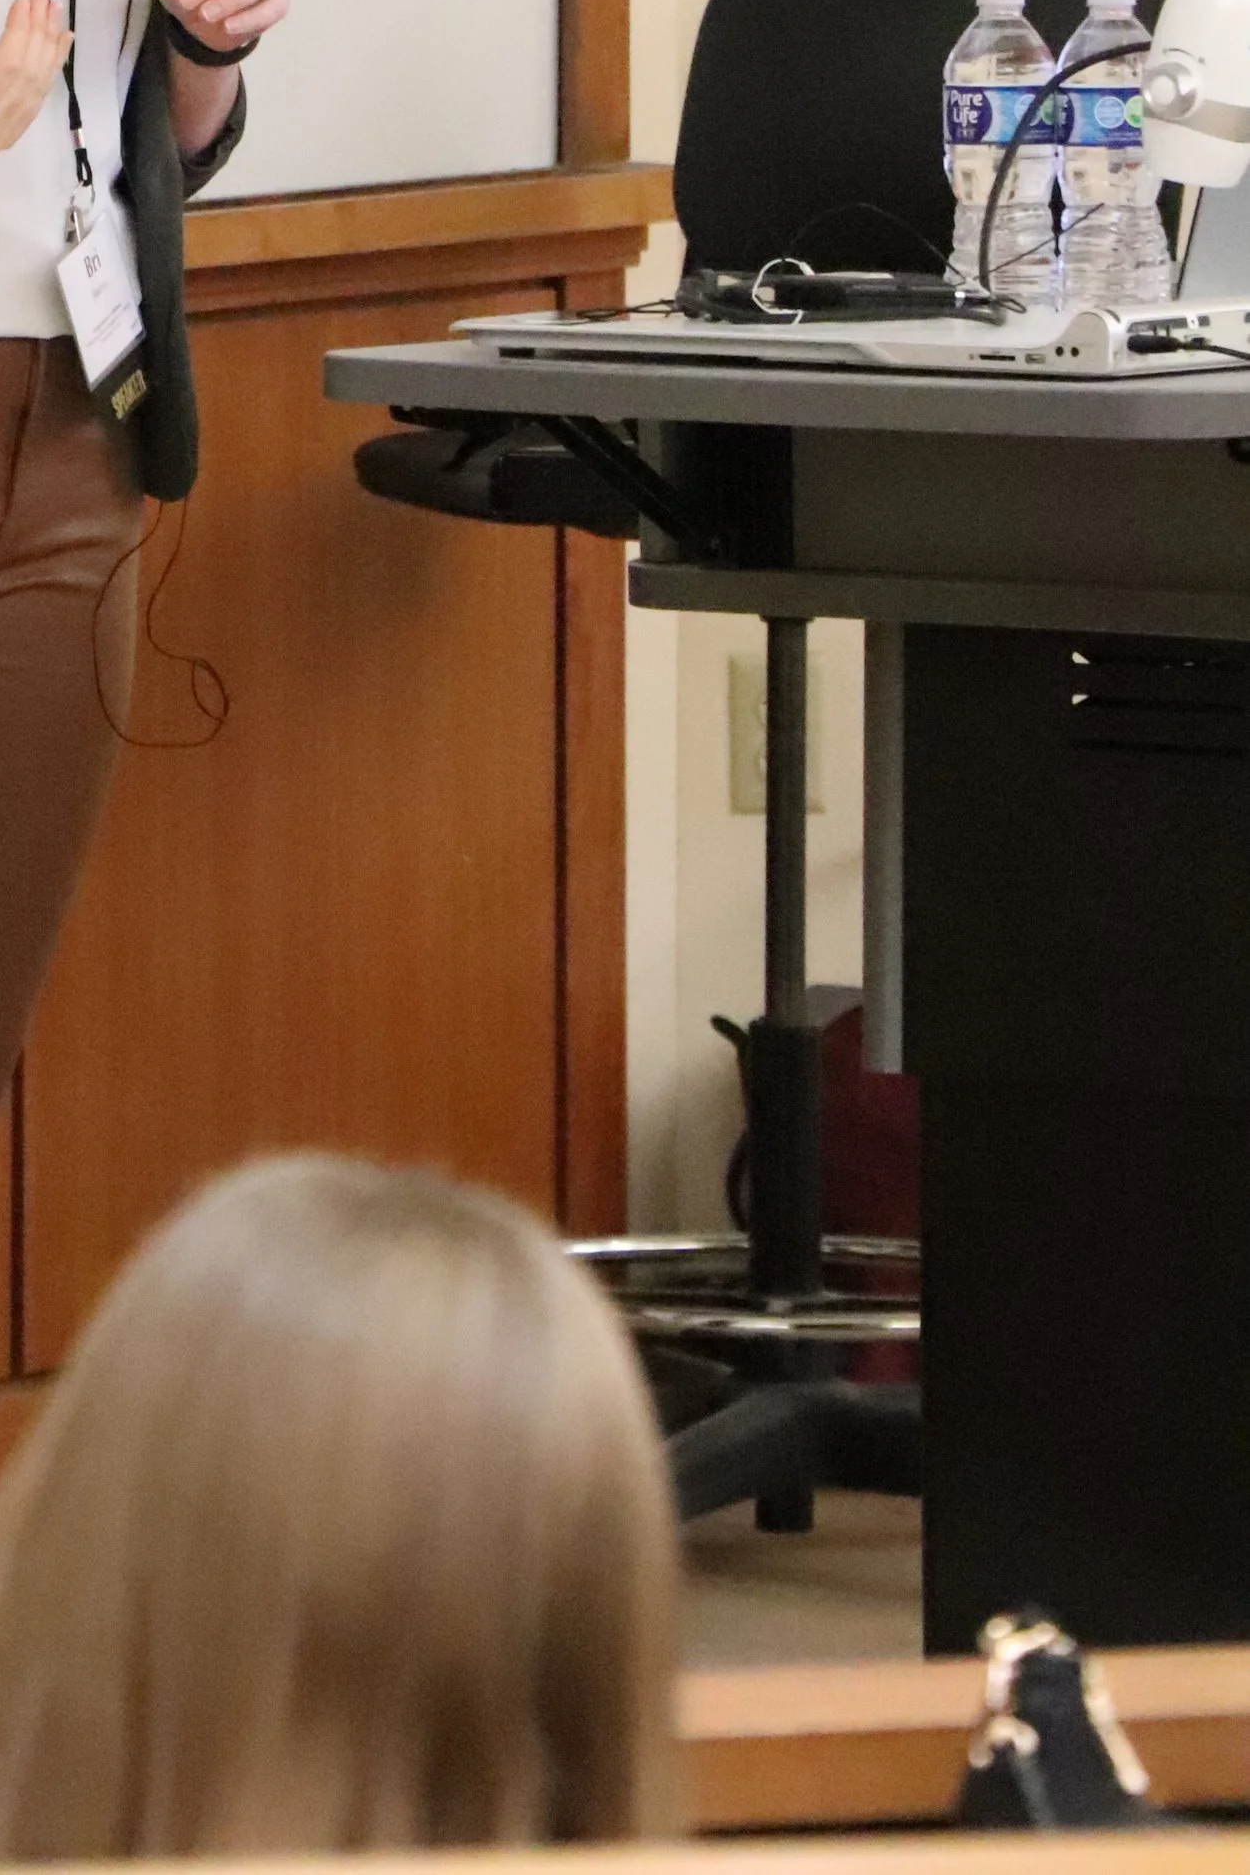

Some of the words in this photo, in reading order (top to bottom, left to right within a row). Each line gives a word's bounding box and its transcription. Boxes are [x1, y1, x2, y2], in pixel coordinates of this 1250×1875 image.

[950, 90, 983, 106] Pure
[953, 106, 979, 127] Life
[83, 246, 102, 278] Bri
